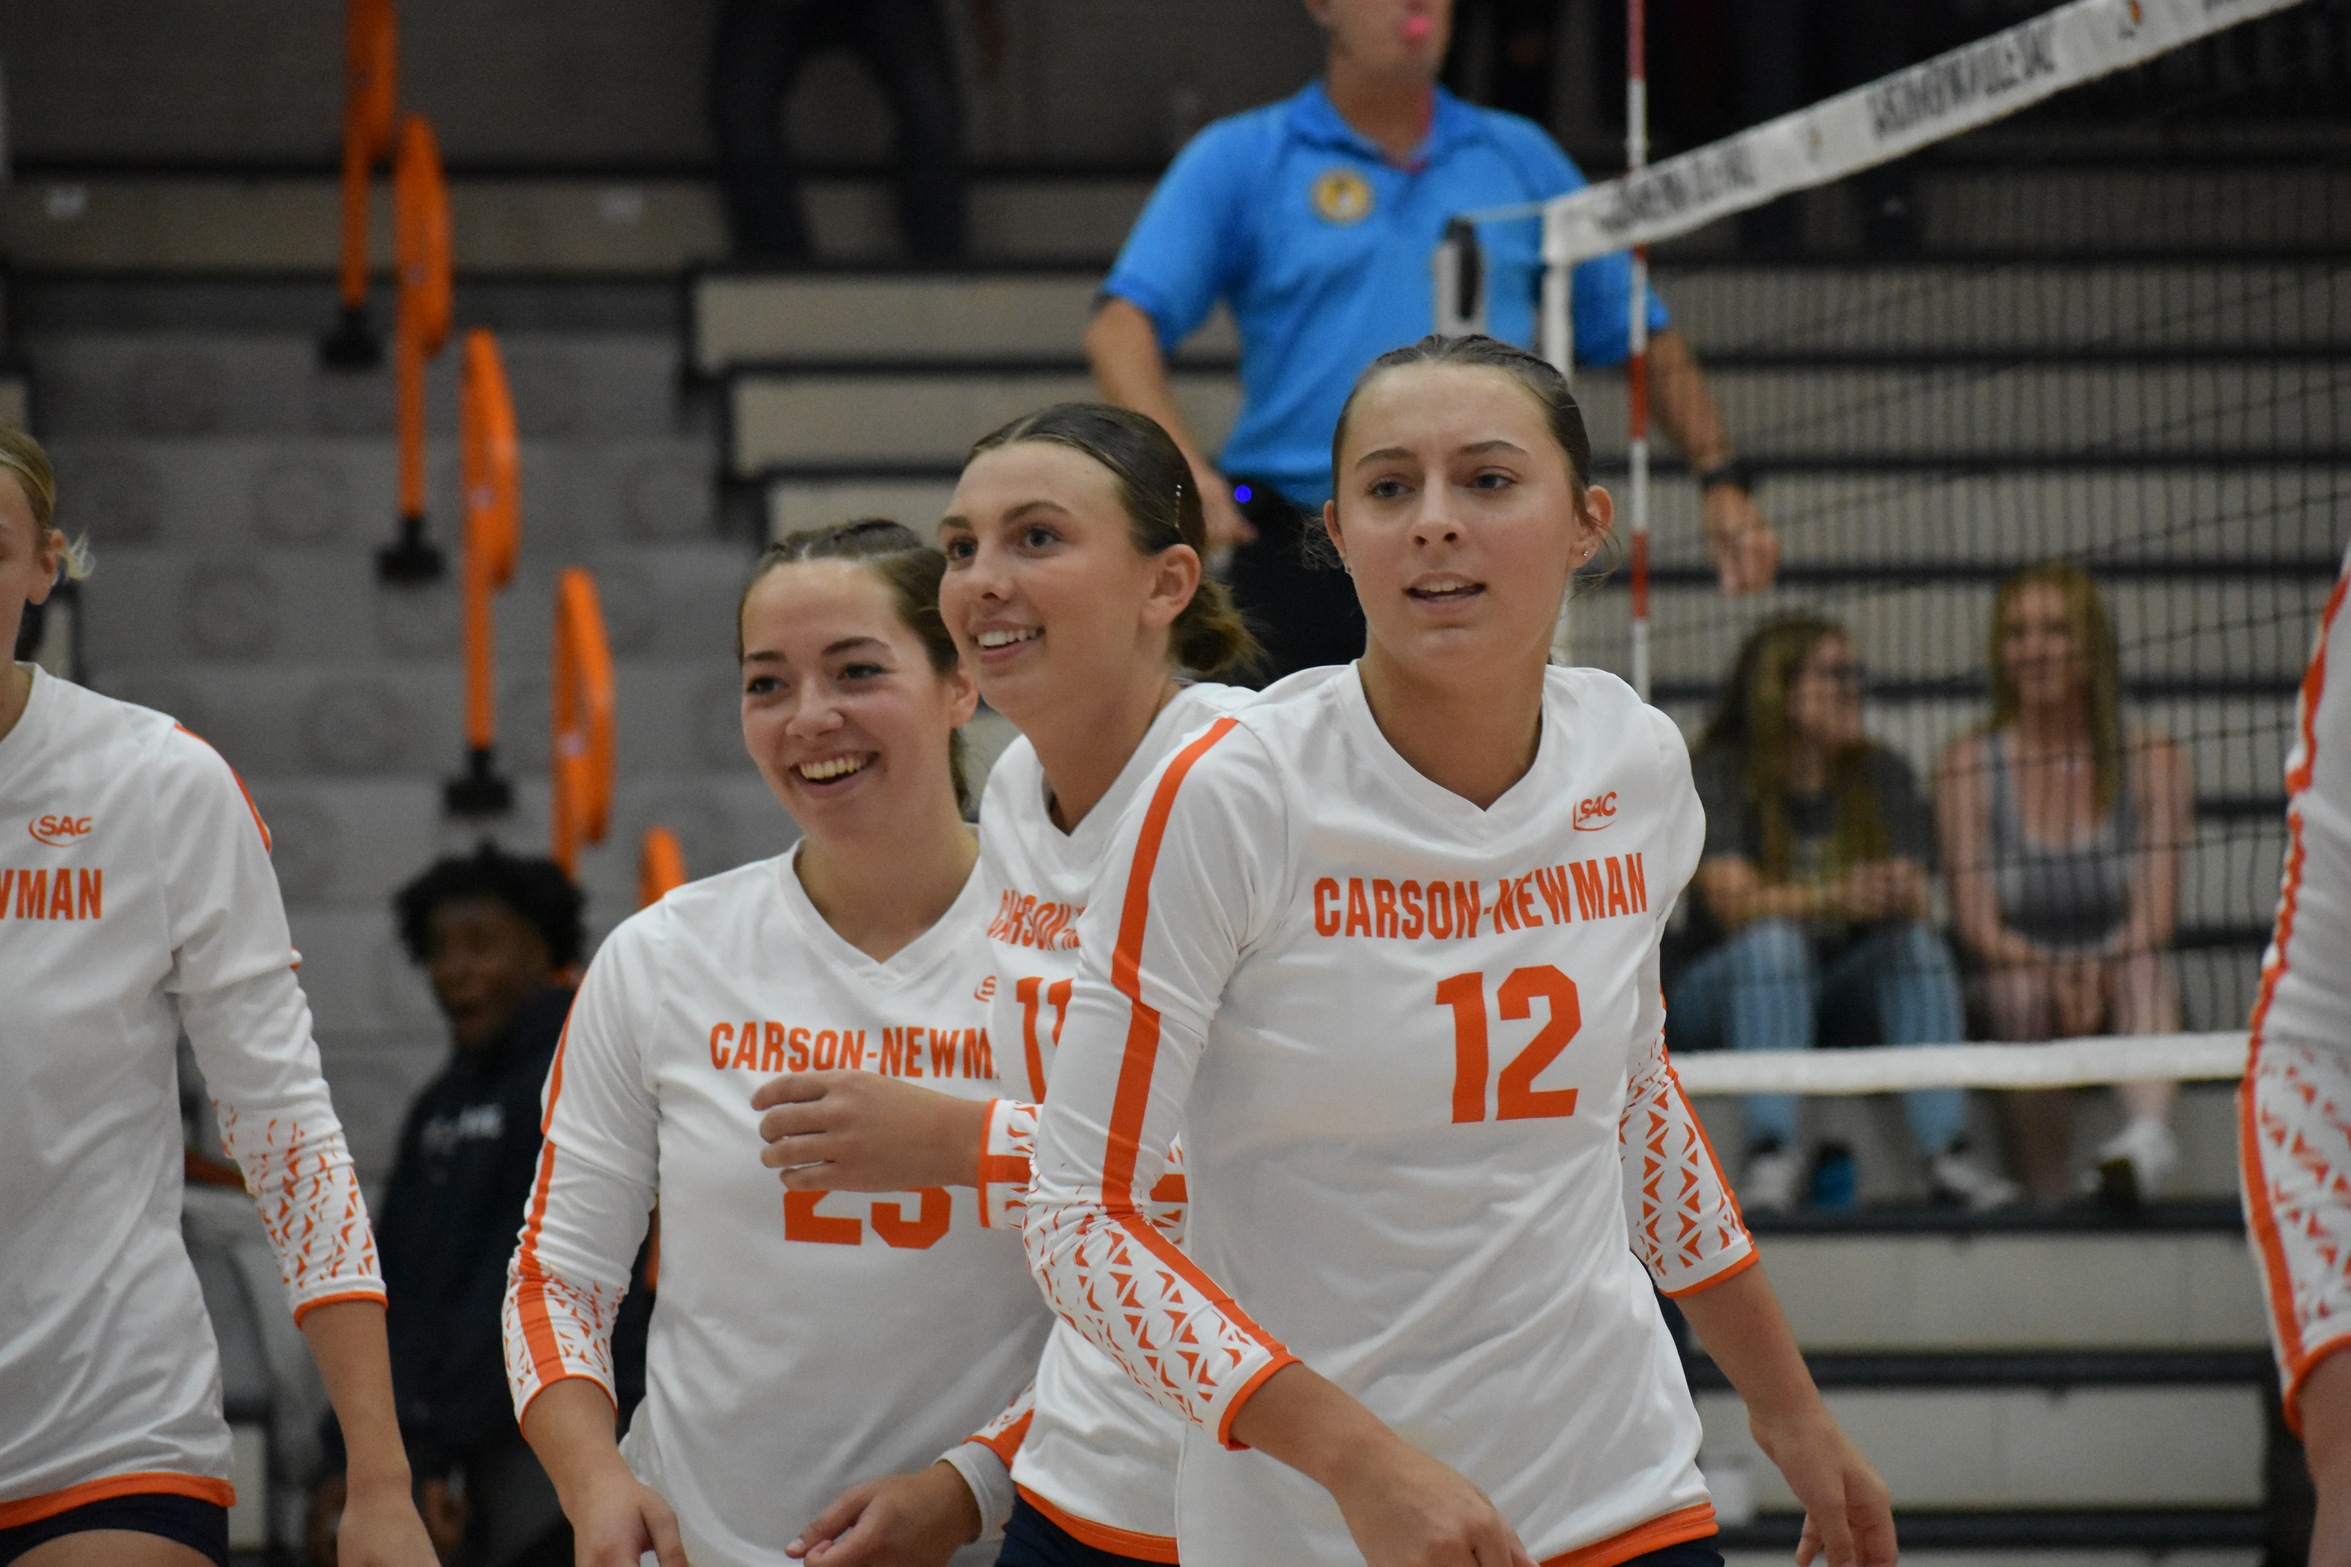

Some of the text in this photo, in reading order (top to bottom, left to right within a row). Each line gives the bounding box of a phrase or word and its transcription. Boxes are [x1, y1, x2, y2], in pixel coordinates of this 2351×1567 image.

[38, 815, 93, 836] SAC
[1578, 791, 1617, 822] SAC
[1313, 852, 1648, 940] CARSON-NEWMAN
[709, 1020, 1001, 1081] CARSON-NEWM
[1435, 964, 1582, 1124] 12
